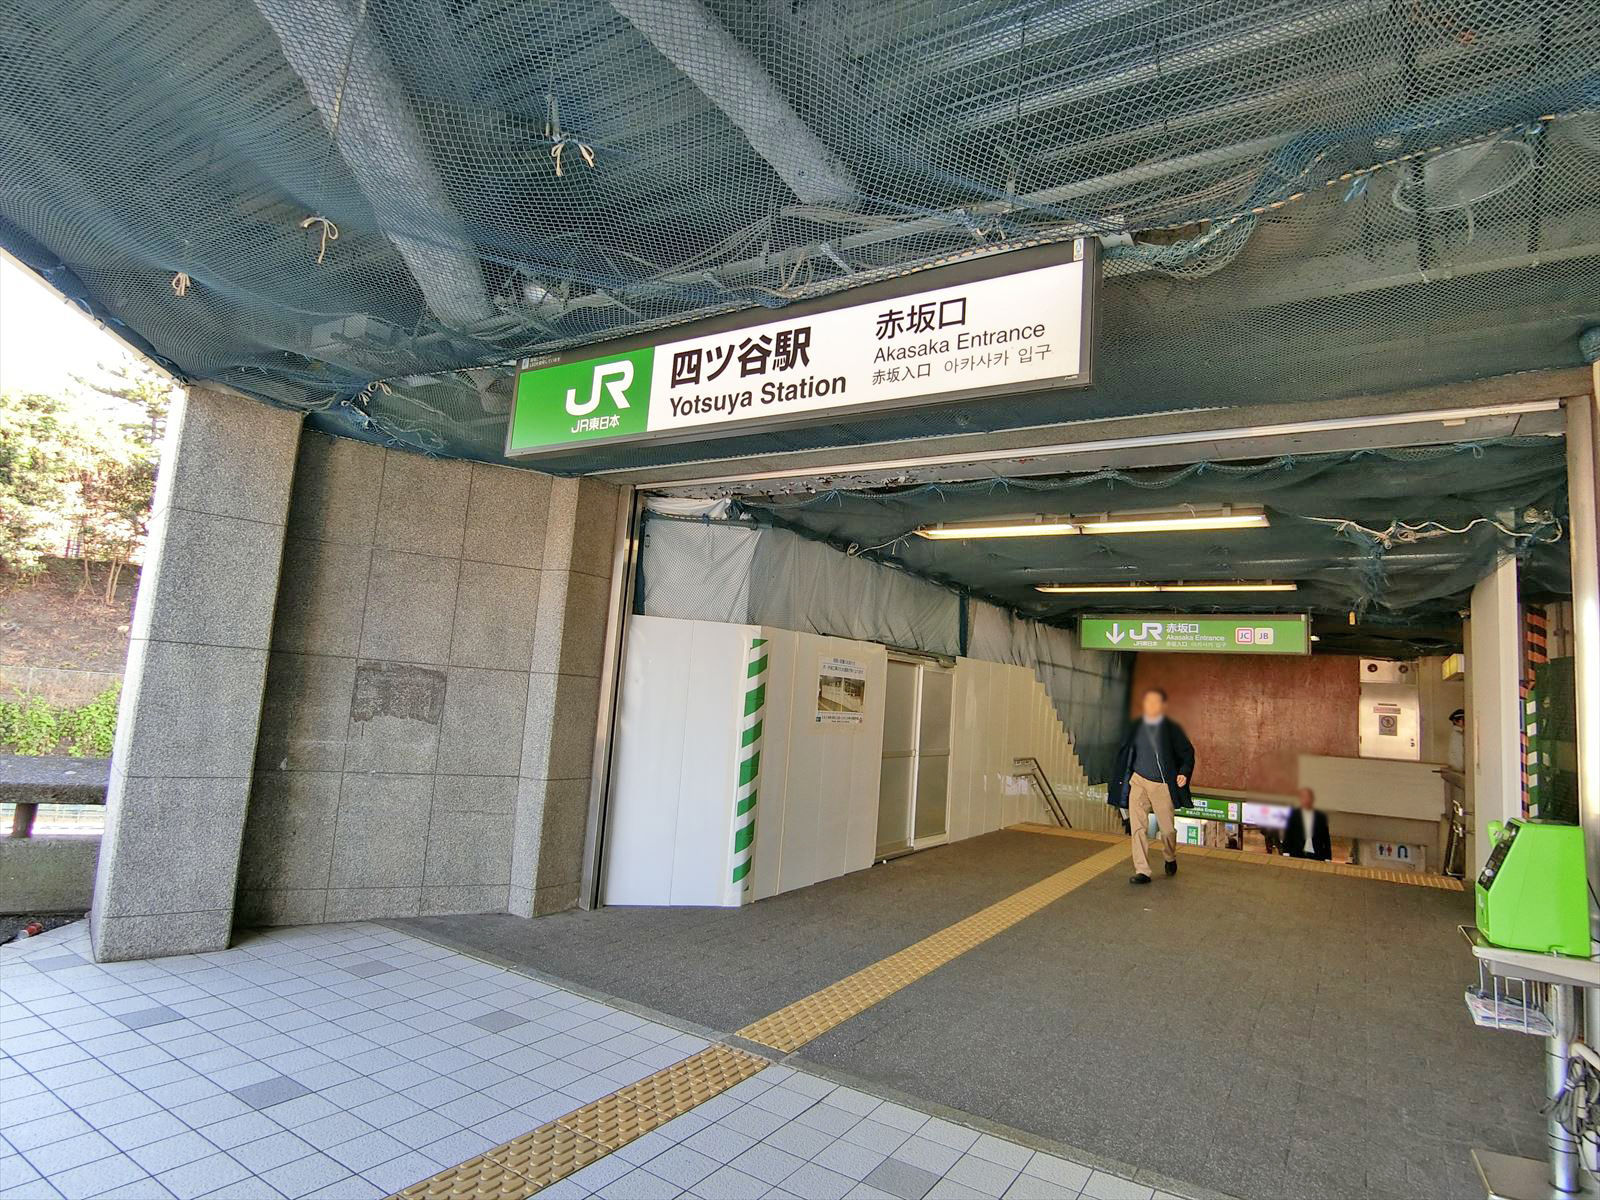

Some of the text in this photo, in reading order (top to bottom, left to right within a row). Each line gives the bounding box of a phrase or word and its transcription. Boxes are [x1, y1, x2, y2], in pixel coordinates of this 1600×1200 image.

[876, 297, 967, 340] 赤坂口
[670, 326, 811, 389] 四ツ谷駅
[873, 324, 1045, 363] Akasaka Entrance
[944, 343, 1052, 374] 아카사카 입구
[565, 359, 634, 416] JR
[872, 363, 931, 385] 赤坂入口
[670, 375, 847, 417] Yotsuya Station
[571, 414, 620, 433] JR東日本
[1129, 622, 1162, 640] JR
[1166, 623, 1199, 633] 赤坂口
[1240, 632, 1269, 640] JC JB
